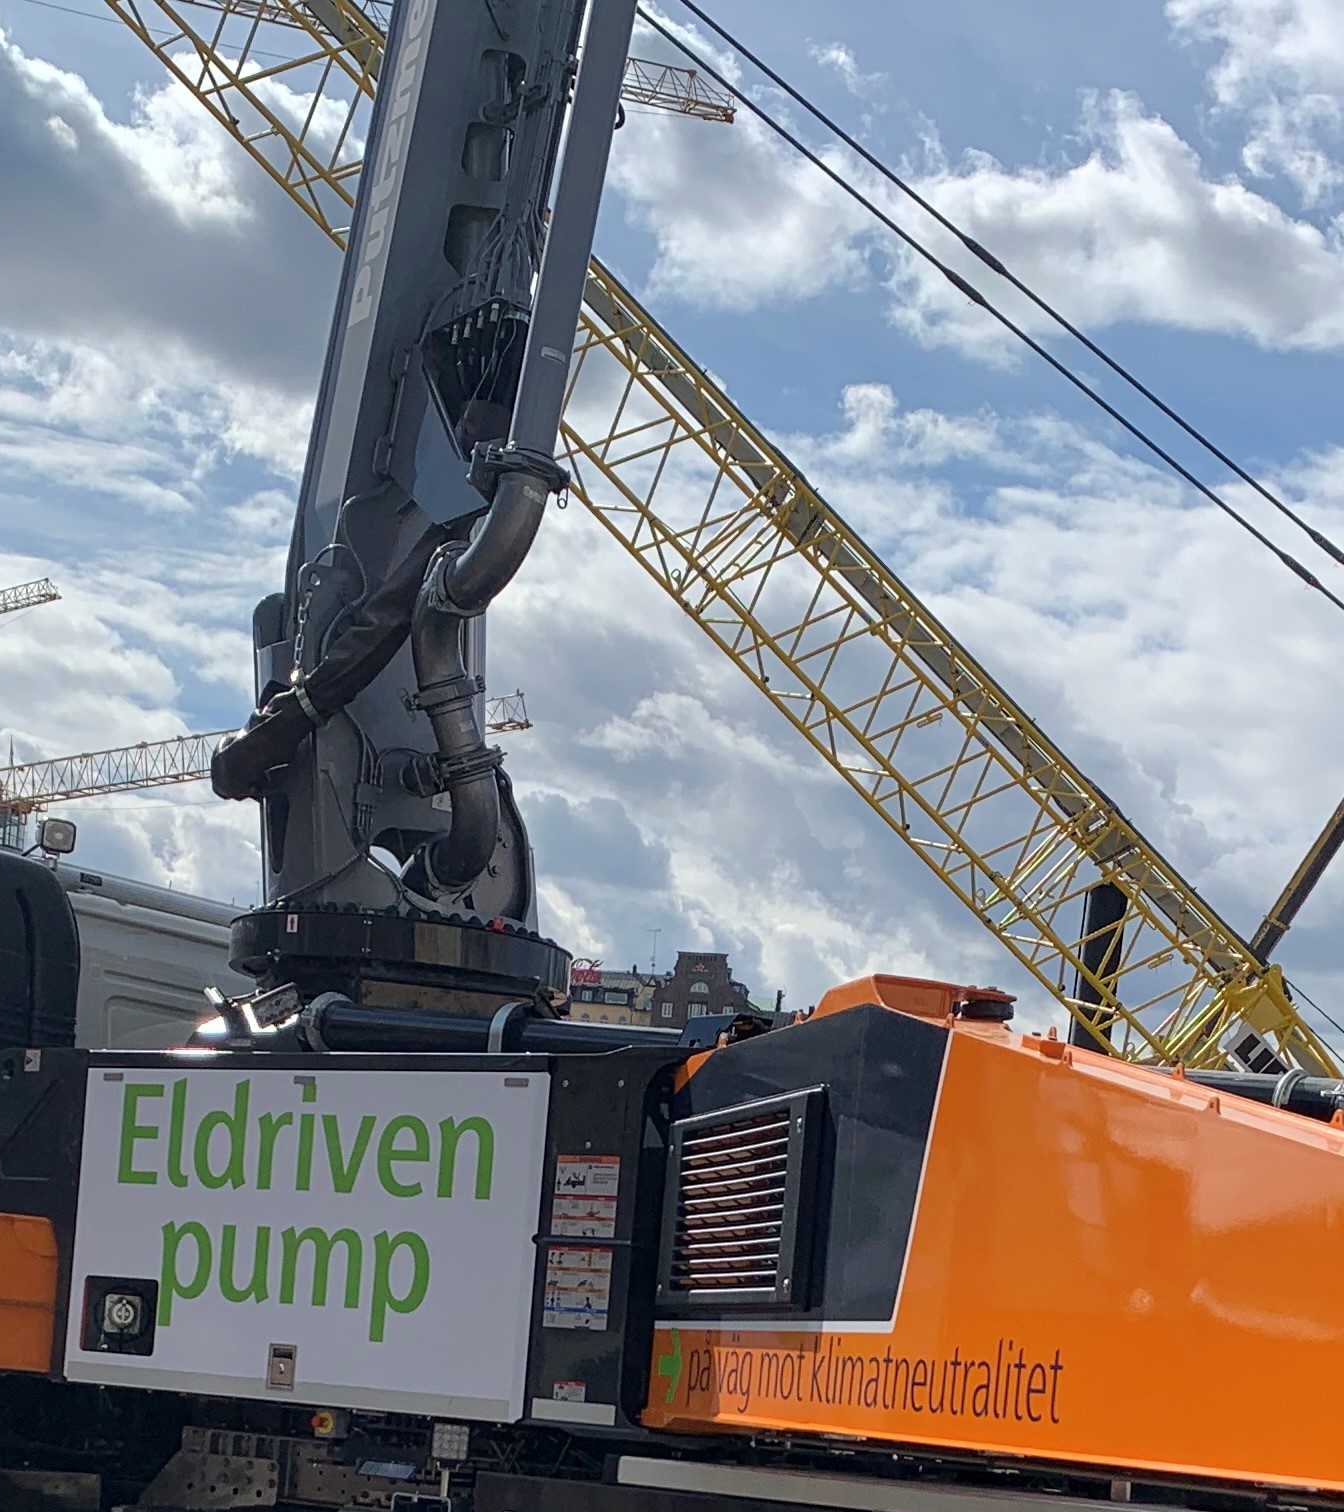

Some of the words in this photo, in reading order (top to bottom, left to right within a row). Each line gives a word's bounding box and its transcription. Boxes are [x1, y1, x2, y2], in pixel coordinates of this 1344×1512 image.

[347, 0, 429, 328] Putzme
[117, 1077, 495, 1200] Eldriven
[157, 1220, 431, 1342] pump
[686, 1332, 712, 1408] på
[716, 1334, 753, 1413] väg
[757, 1345, 806, 1401] mot
[810, 1336, 1064, 1424] klimatneutralitet
